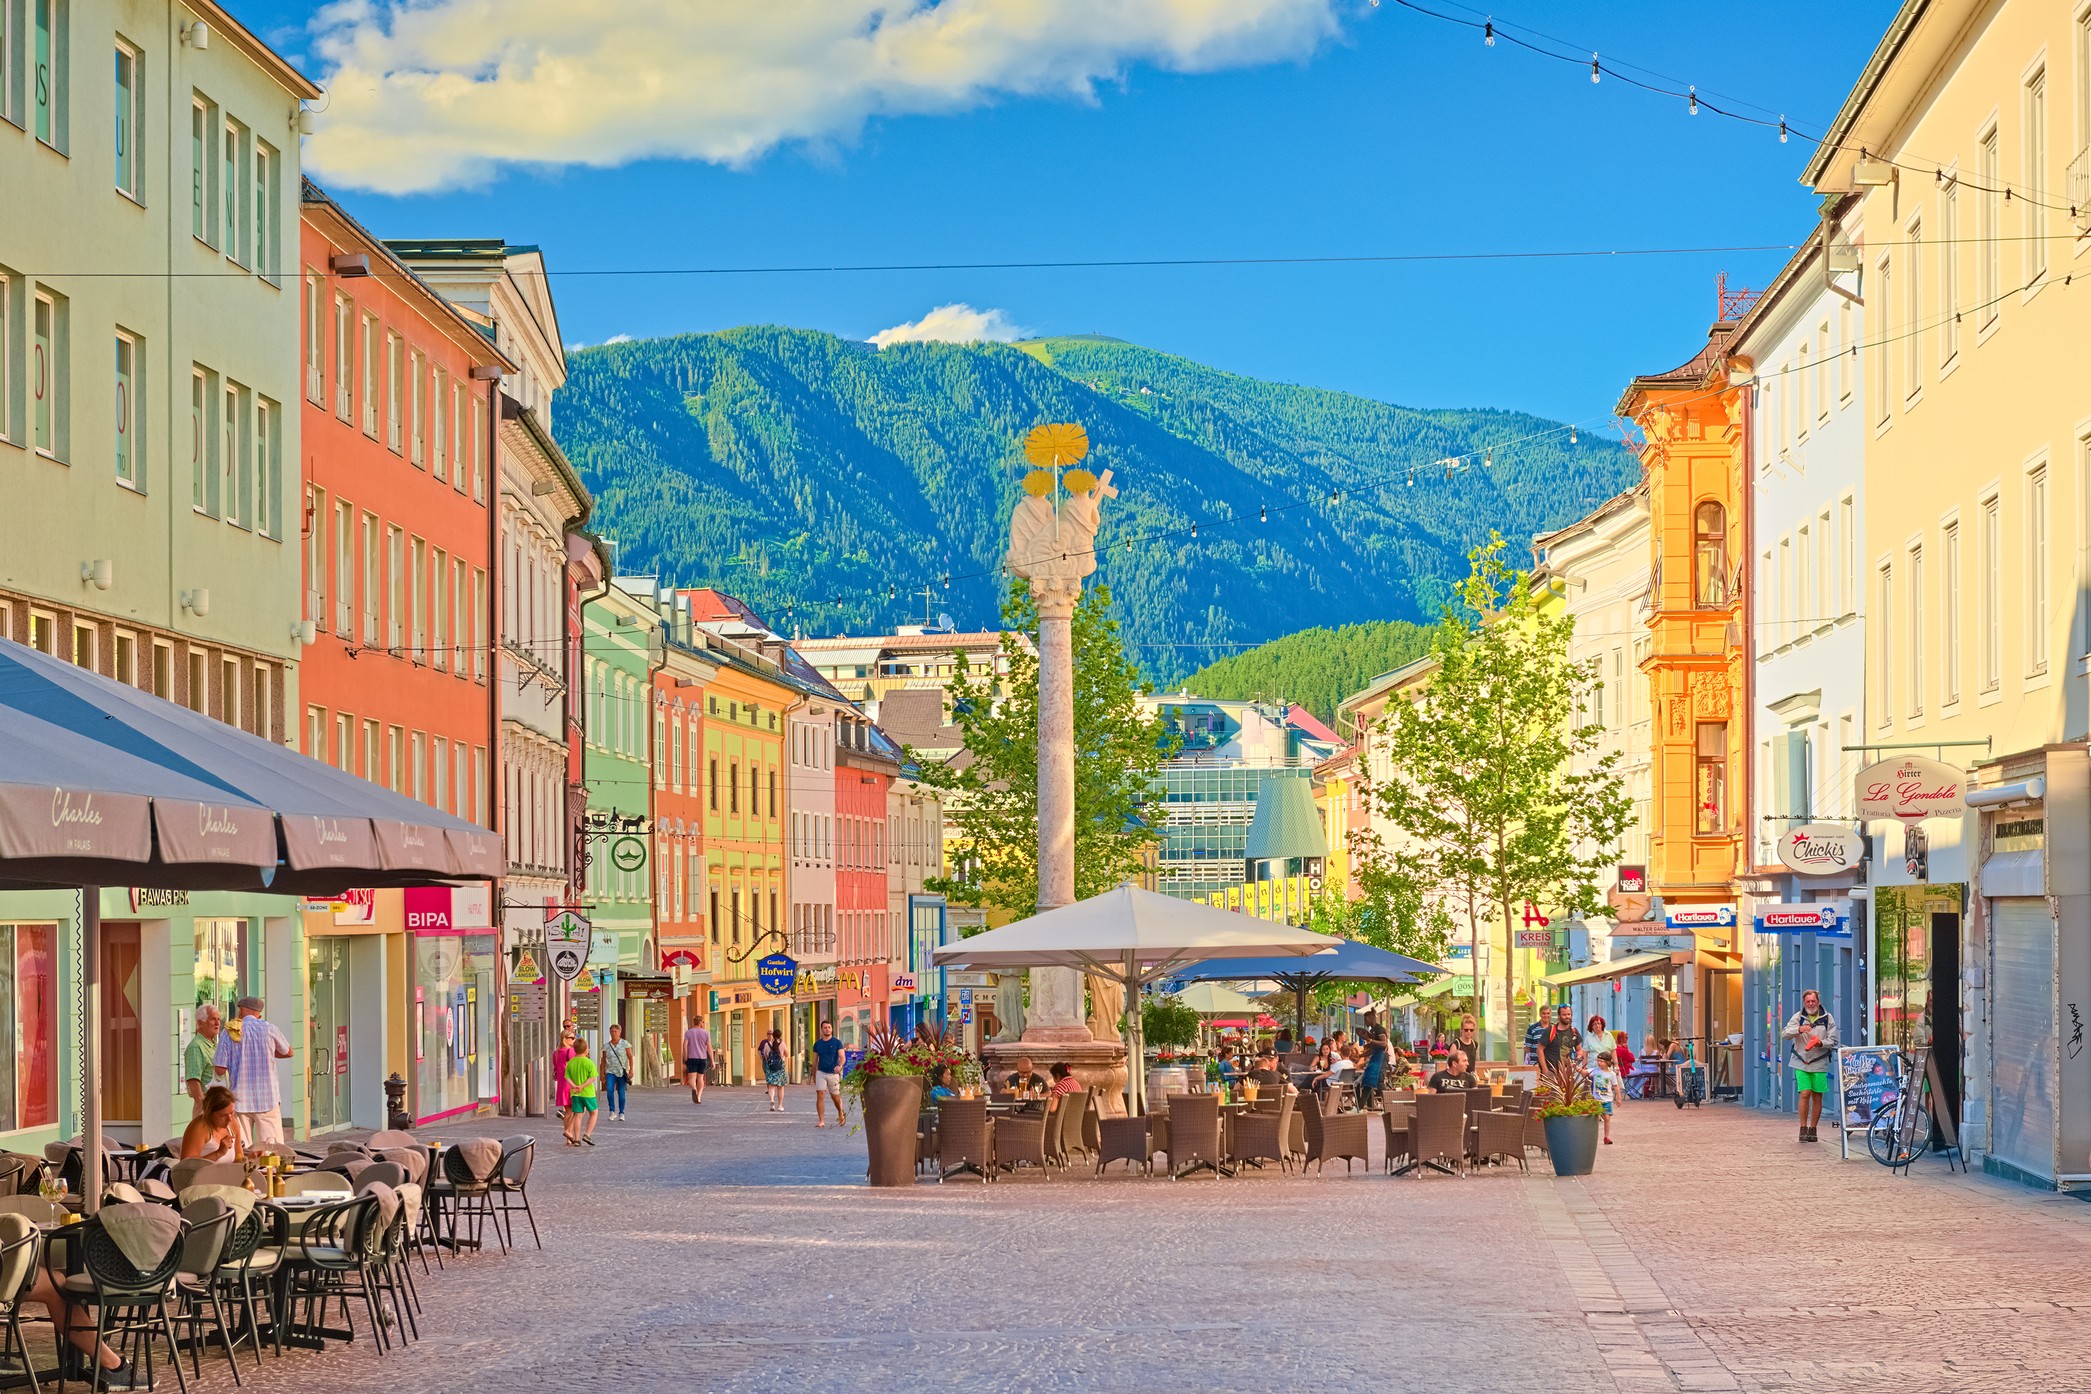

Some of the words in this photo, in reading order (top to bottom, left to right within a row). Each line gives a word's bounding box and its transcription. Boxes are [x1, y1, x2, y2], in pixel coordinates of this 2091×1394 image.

[1897, 769, 1922, 779] Hirter
[1862, 782, 1891, 801] La
[1896, 781, 1958, 806] Gondola
[51, 786, 103, 827] Charles
[1861, 808, 1892, 818] Trattoria
[1934, 807, 1962, 817] Pizzeria
[199, 802, 239, 837] Charles
[313, 815, 348, 845] Charles
[1793, 840, 1847, 866] Chickis
[140, 888, 172, 906] BAWAG
[408, 912, 449, 927] BIPA
[1677, 913, 1717, 922] Hartlauer
[1770, 914, 1817, 924] Hartlauer
[1520, 932, 1551, 941] KREIS
[760, 967, 794, 977] Hofwirt
[895, 976, 913, 987] dm
